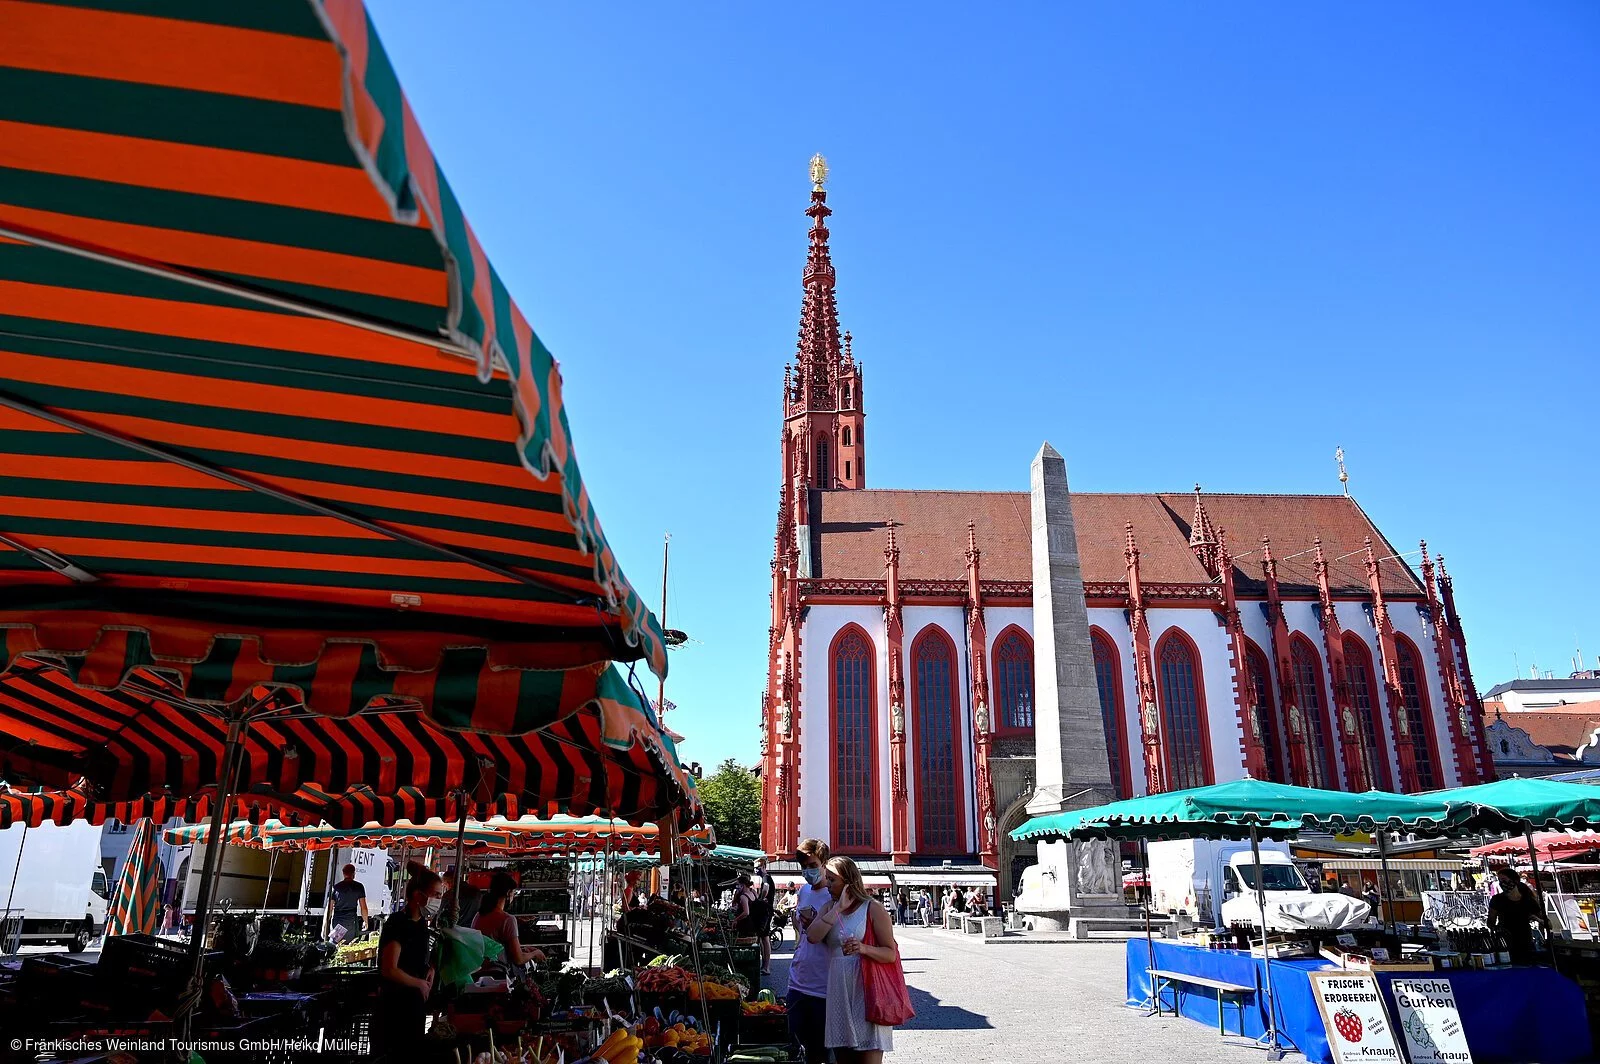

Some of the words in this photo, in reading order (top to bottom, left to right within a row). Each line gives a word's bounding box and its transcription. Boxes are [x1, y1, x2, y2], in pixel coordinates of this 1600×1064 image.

[350, 849, 375, 866] VENT
[1328, 979, 1365, 989] FRISCHE
[1393, 980, 1450, 993] Frische
[1324, 993, 1377, 1003] ERDBEEREN
[1398, 995, 1455, 1008] Gurken
[1361, 1046, 1396, 1058] Knaup
[1433, 1050, 1469, 1062] Knaup
